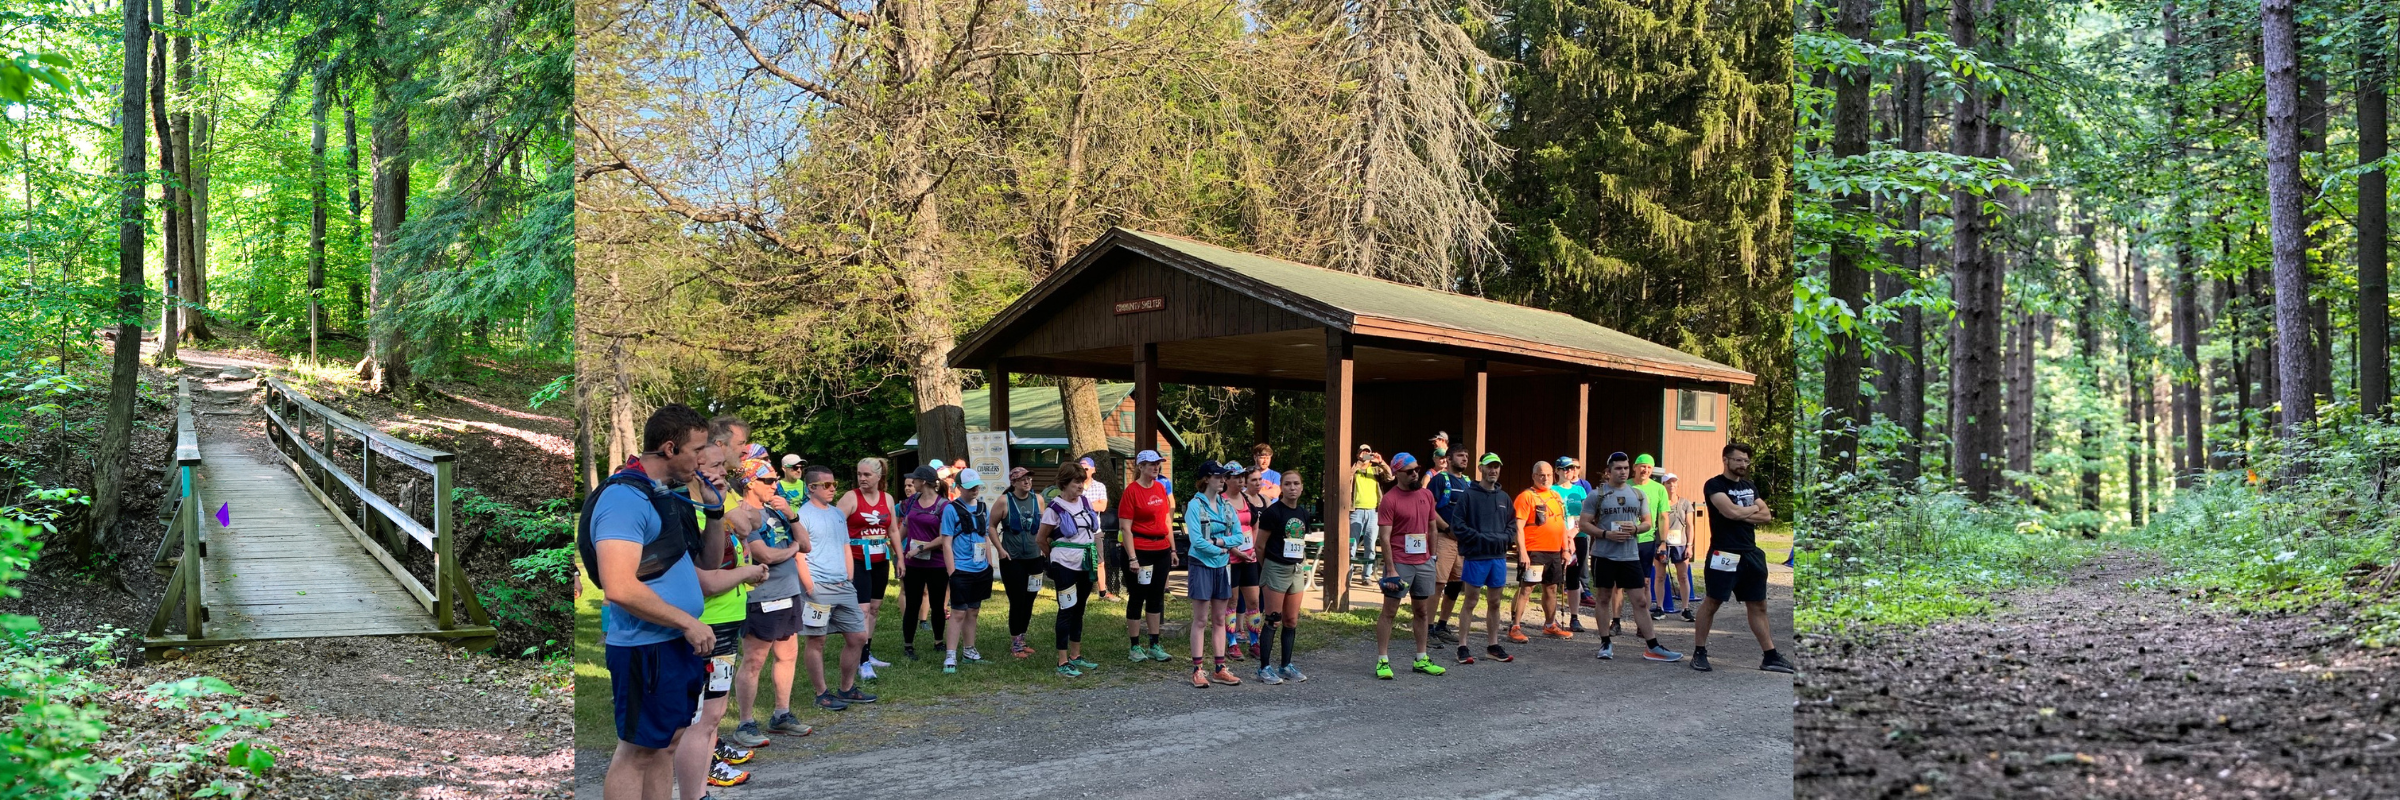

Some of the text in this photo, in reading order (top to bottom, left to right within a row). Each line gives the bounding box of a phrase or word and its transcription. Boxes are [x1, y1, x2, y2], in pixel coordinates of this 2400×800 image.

[1141, 299, 1162, 310] SHELTER
[977, 465, 1000, 473] CHARGERS
[1604, 507, 1621, 515] BEAT
[1290, 543, 1301, 552] 133
[1413, 539, 1421, 548] 26
[1720, 557, 1731, 566] 62
[1532, 569, 1537, 577] 6
[811, 610, 823, 620] 36
